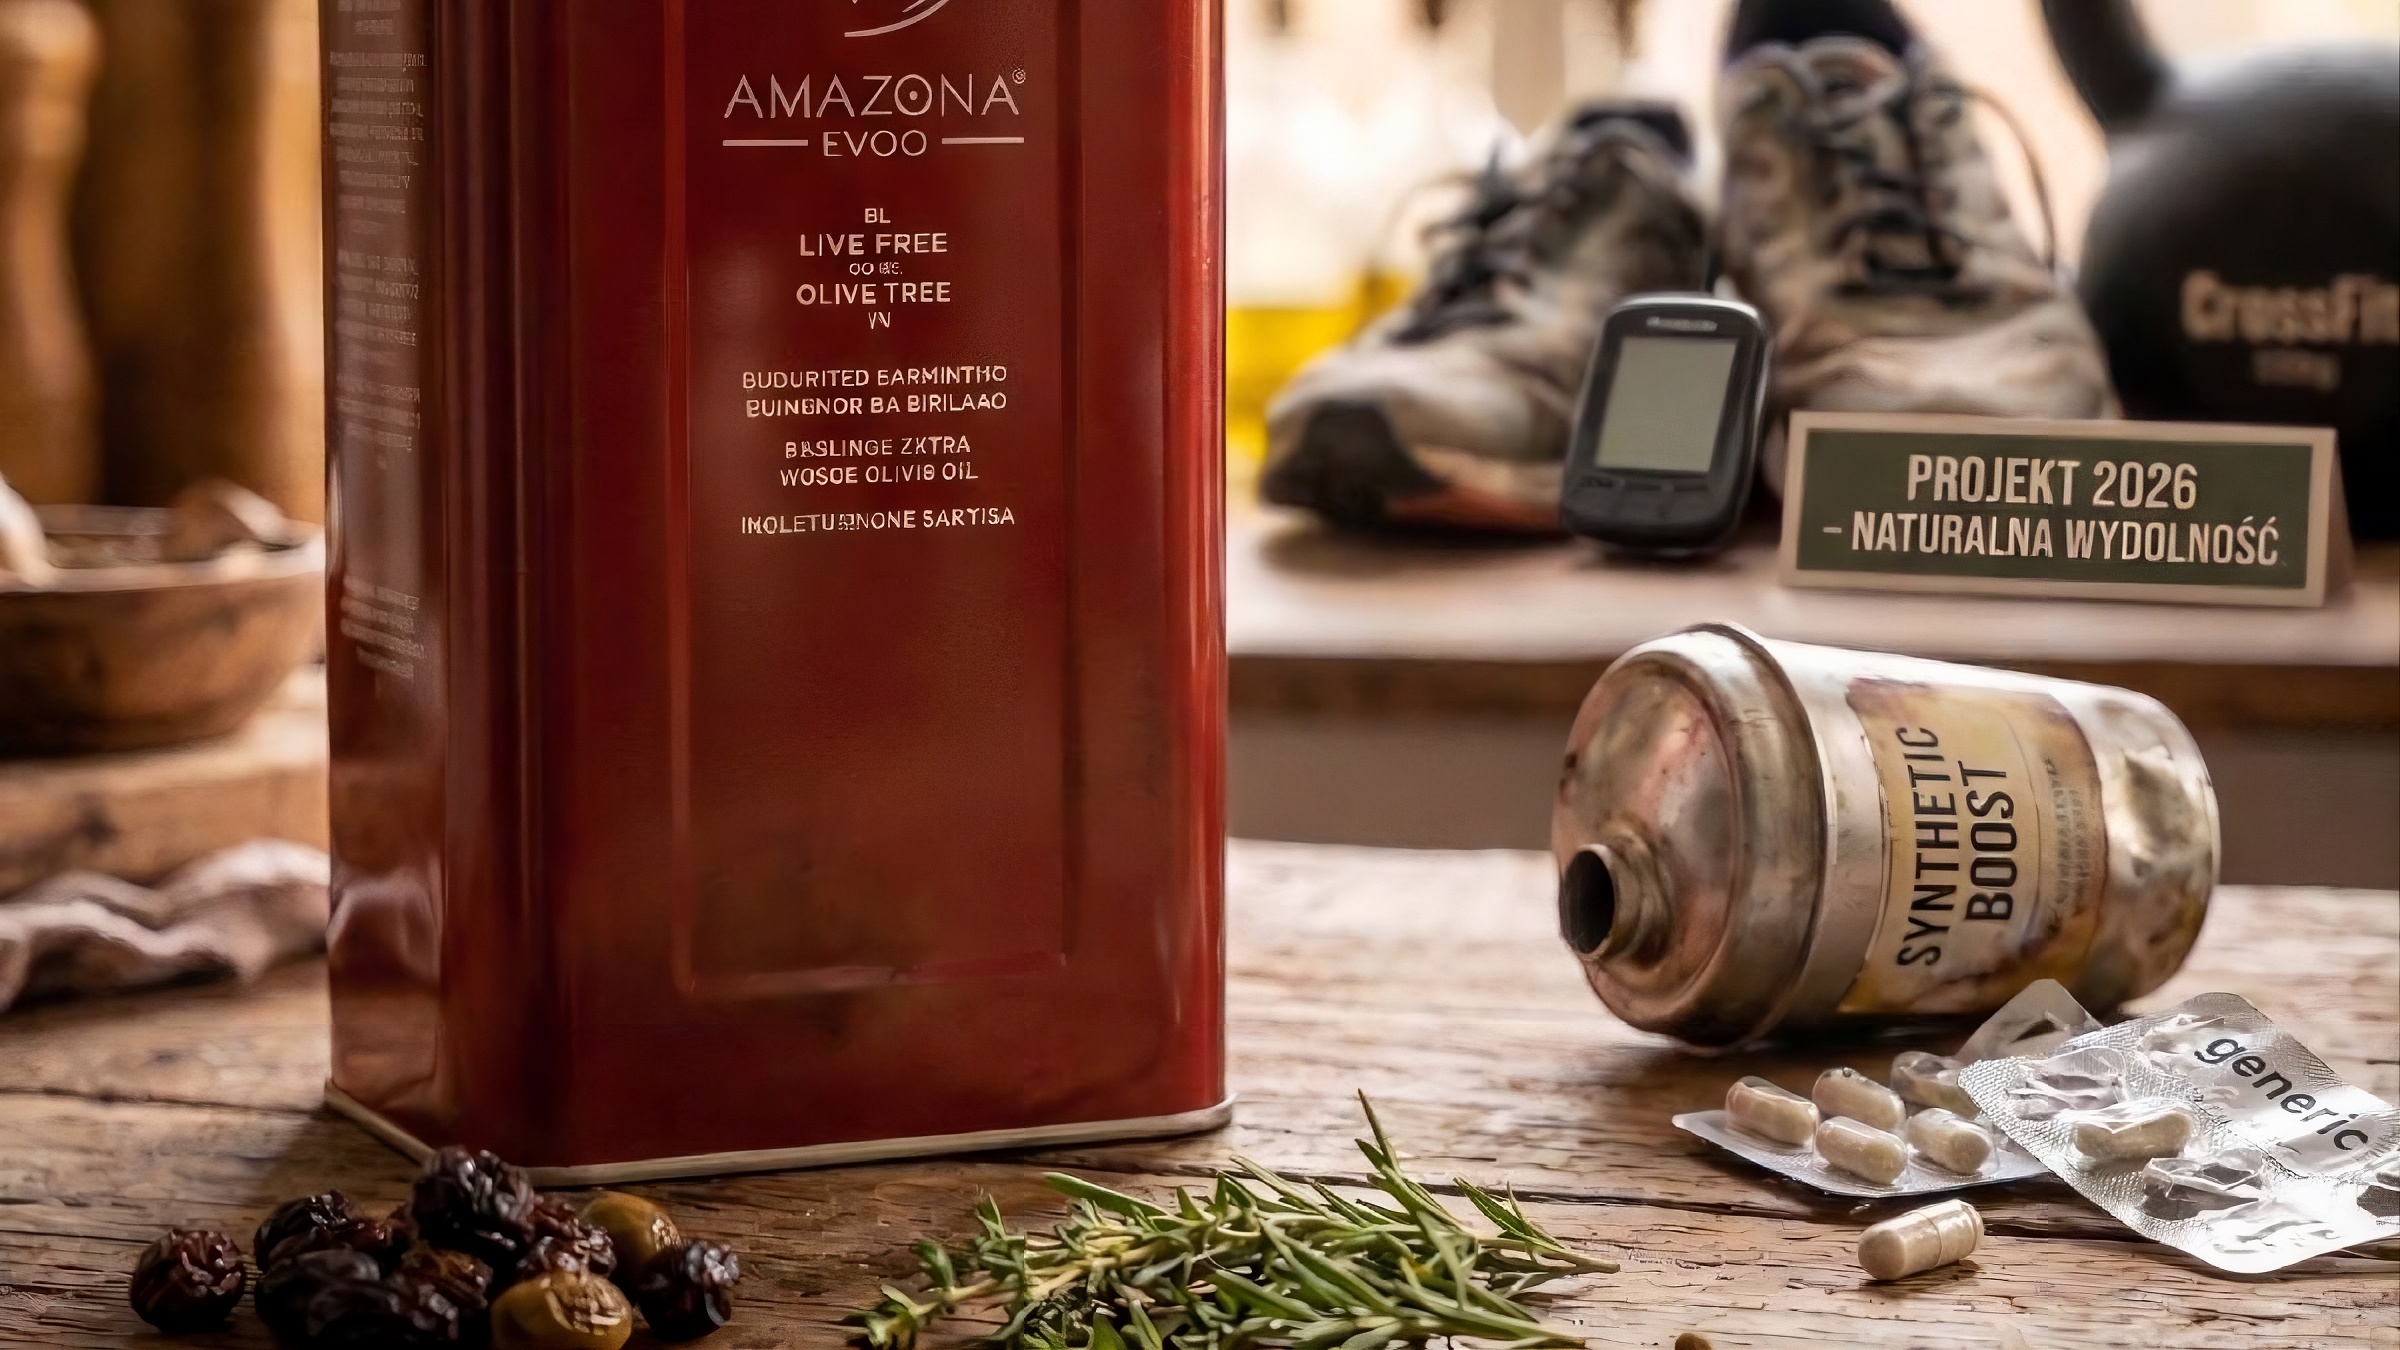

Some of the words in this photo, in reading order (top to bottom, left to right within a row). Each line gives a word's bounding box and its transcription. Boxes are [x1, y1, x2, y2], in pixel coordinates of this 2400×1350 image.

[823, 130, 927, 157] EVOO
[864, 208, 891, 224] BL
[800, 234, 865, 257] LIVE
[875, 232, 948, 254] FREE
[796, 283, 877, 306] OLIVE
[883, 282, 951, 303] TREE
[870, 396, 901, 414] BA
[942, 462, 979, 481] OIL
[1906, 453, 2081, 507] PROJEKT
[2092, 460, 2198, 510] 2026
[1851, 511, 2054, 559] NATURALNA
[2064, 514, 2280, 567] WYDOLNOŚĆ
[1894, 726, 1960, 966] SYNTHETIC
[1957, 760, 2018, 921] BOOST
[2193, 1037, 2369, 1152] generic
